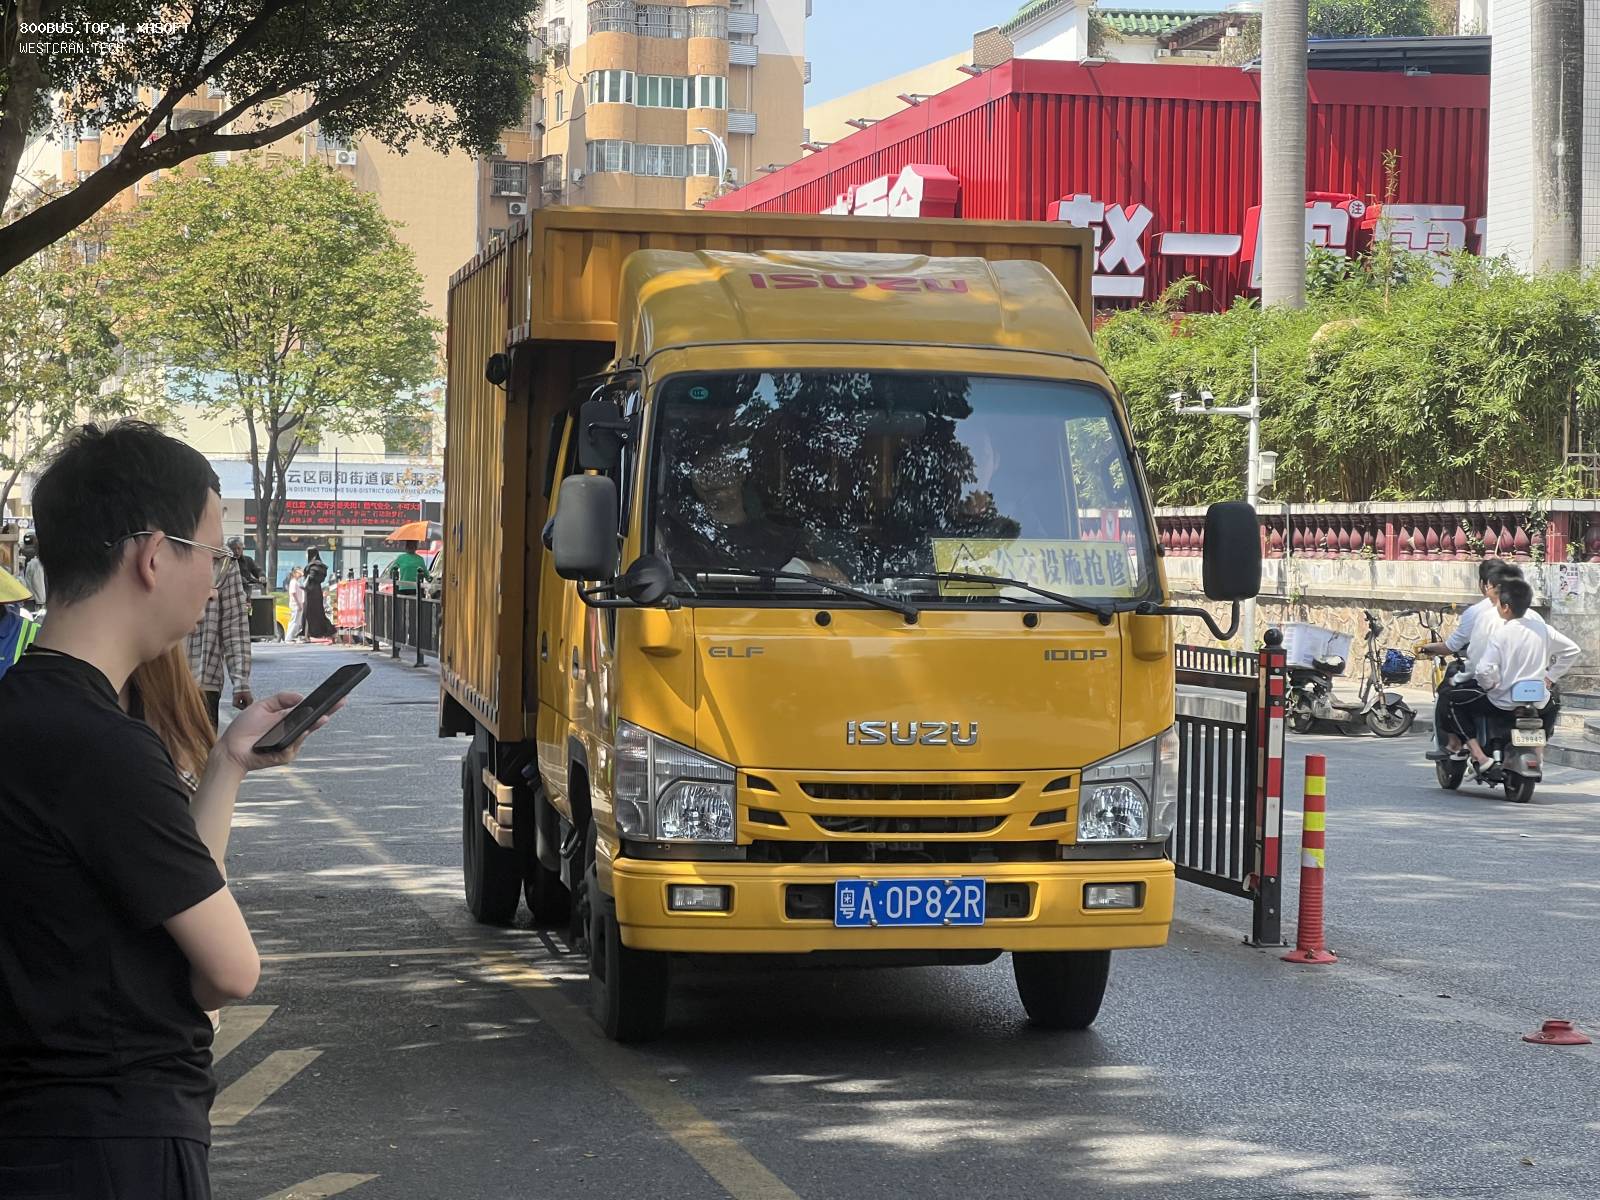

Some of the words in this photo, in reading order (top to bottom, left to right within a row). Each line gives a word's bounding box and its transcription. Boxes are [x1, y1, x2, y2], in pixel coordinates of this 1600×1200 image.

[749, 272, 969, 294] ISUZU
[996, 547, 1128, 587] 公交设施抢修
[708, 646, 764, 659] ELF
[1044, 649, 1108, 662] 100P
[846, 720, 979, 746] ISUZU
